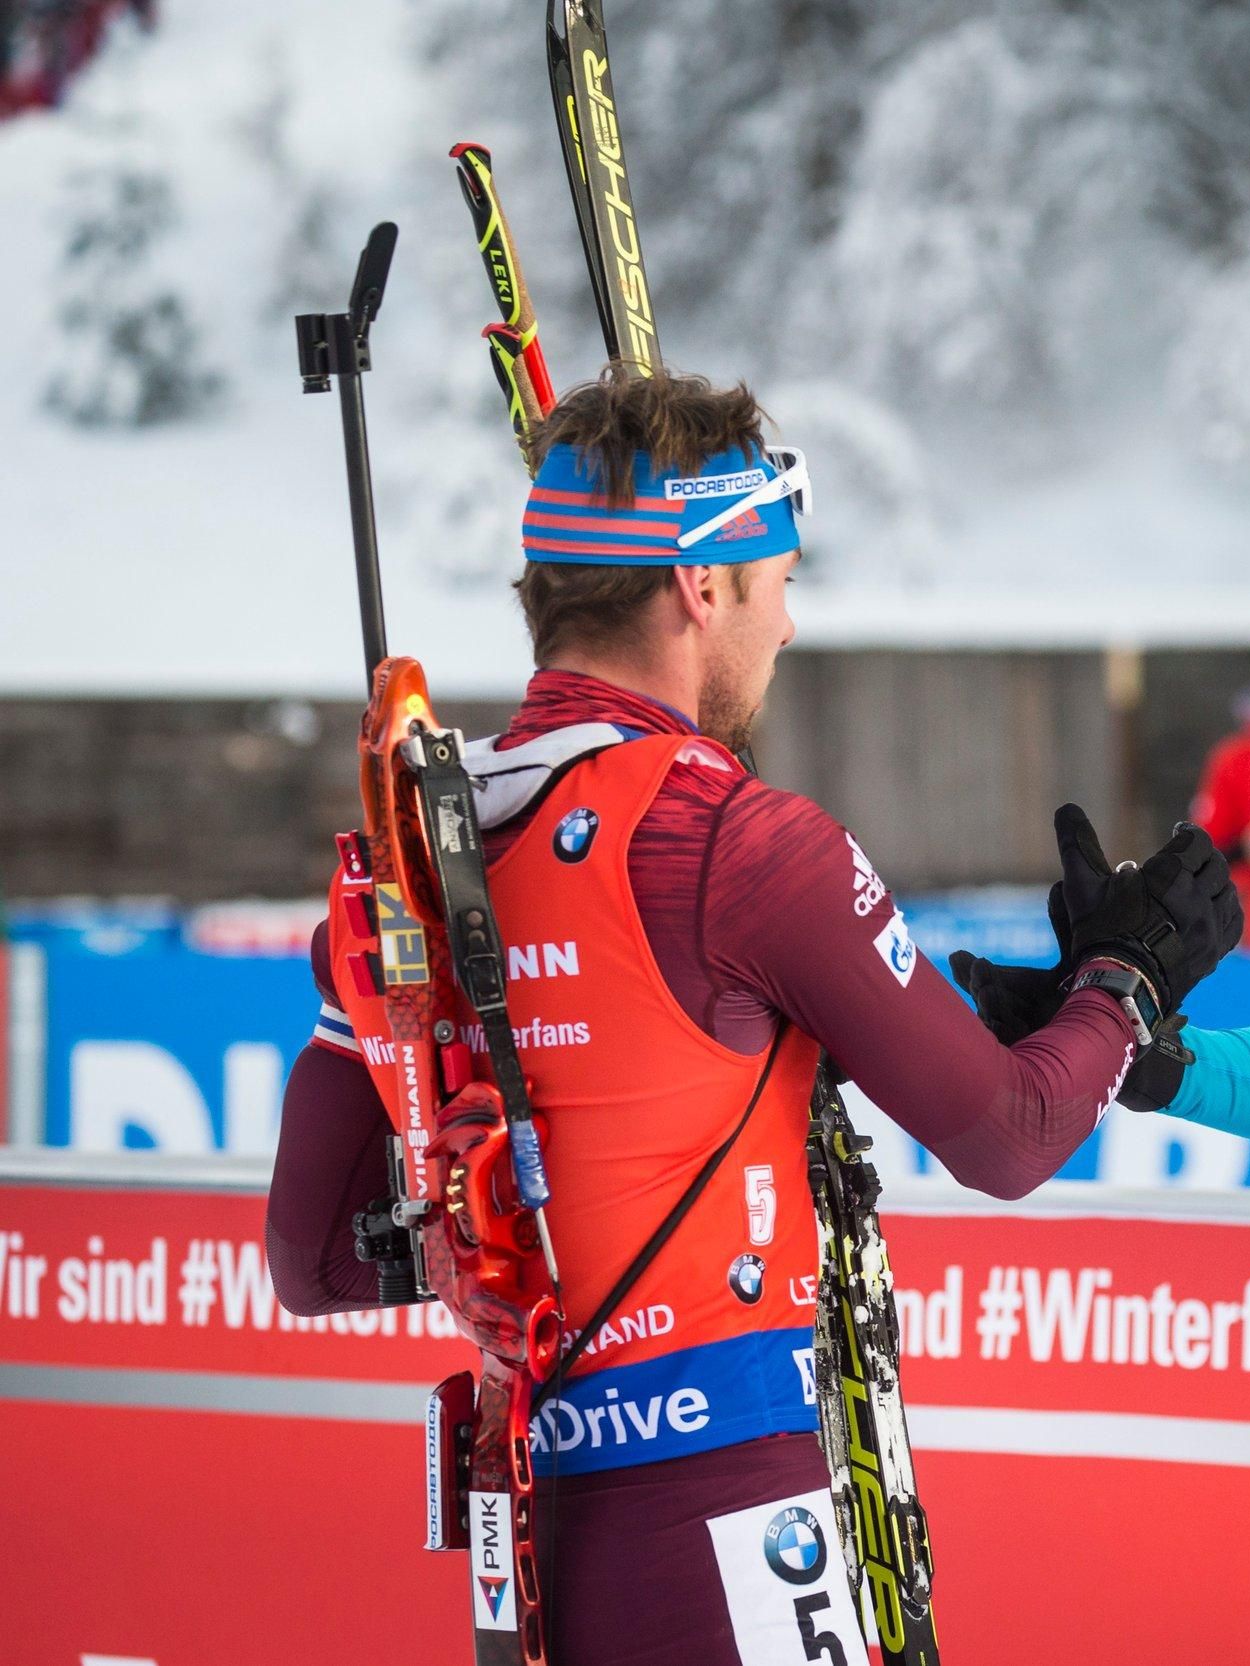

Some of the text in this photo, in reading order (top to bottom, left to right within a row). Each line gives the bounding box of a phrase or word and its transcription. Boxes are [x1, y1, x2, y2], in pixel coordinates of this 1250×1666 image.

[582, 48, 654, 379] FISCHER
[489, 249, 512, 304] LEKI
[460, 1017, 591, 1054] Wierfans
[744, 1164, 777, 1246] 5
[0, 1231, 47, 1320] ir
[58, 1236, 167, 1325] sind
[897, 1265, 964, 1360] nd
[767, 1509, 819, 1539] BMW
